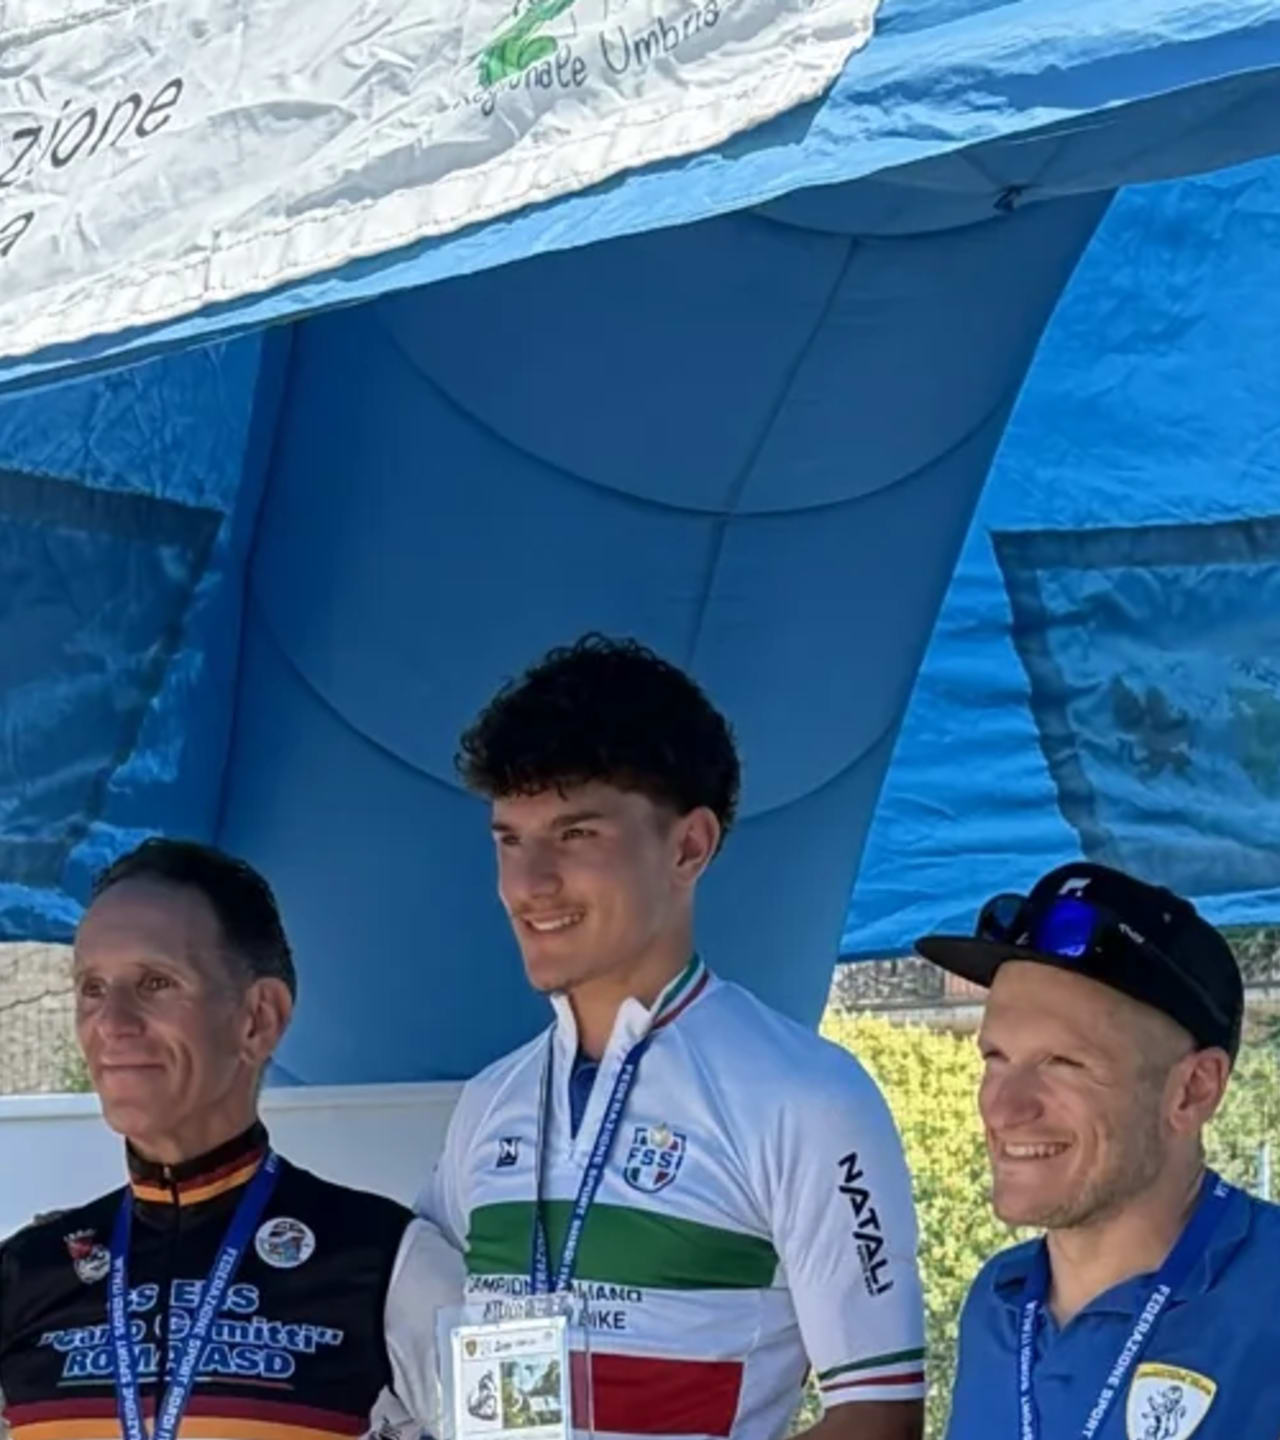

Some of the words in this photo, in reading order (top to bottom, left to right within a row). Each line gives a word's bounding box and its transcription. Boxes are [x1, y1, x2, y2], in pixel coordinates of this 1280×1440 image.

[627, 1147, 683, 1171] FSSI
[838, 1152, 894, 1295] NATALI
[198, 1342, 295, 1379] ASD
[1107, 1285, 1171, 1387] FEDERAZIONE
[1083, 1388, 1114, 1440] SPORT
